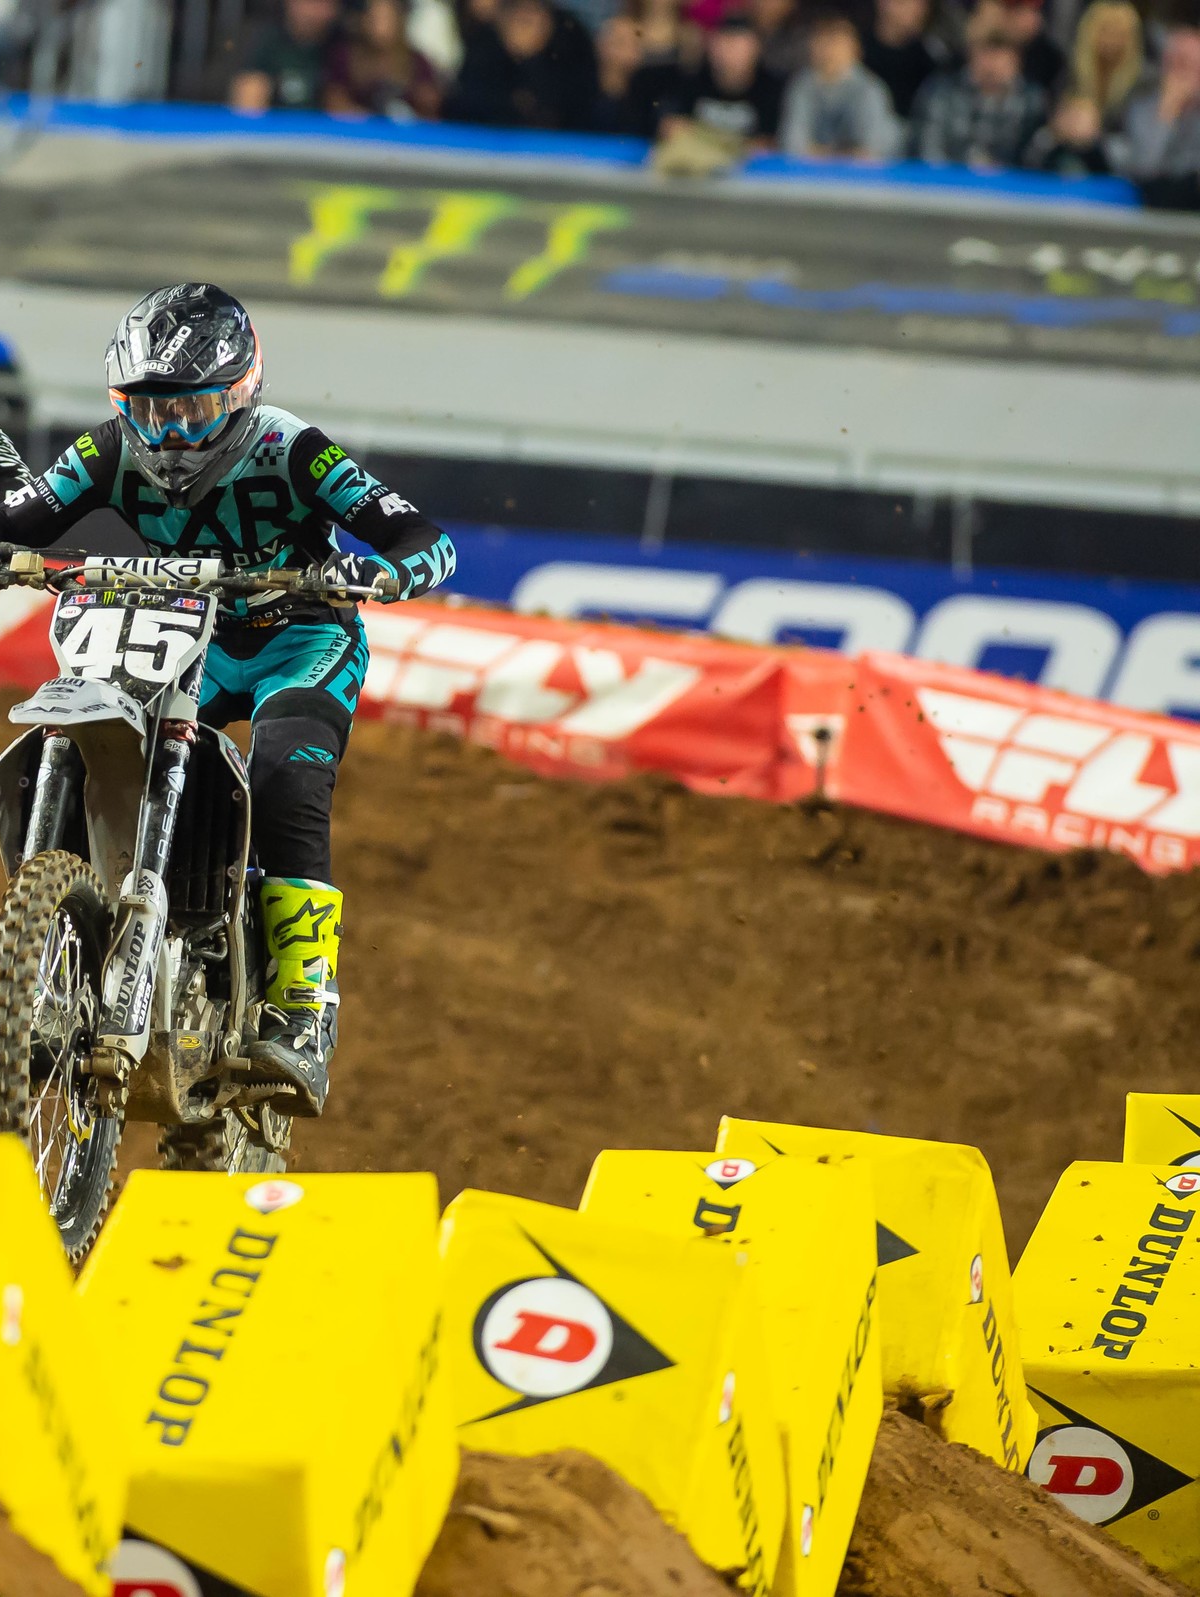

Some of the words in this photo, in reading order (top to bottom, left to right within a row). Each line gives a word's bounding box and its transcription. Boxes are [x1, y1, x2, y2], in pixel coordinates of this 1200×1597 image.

[133, 361, 169, 374] SHOEI
[160, 325, 192, 362] OGIO
[122, 470, 298, 548] FXR
[171, 597, 205, 610] AMA
[61, 607, 202, 684] 45
[970, 794, 1188, 860] RACING
[111, 920, 147, 1030] DUNLOP
[1177, 1175, 1198, 1190] D
[1092, 1202, 1196, 1361] DUNLOP
[145, 1226, 279, 1448] DUNLOP
[493, 1309, 598, 1364] D
[1040, 1454, 1125, 1497] D
